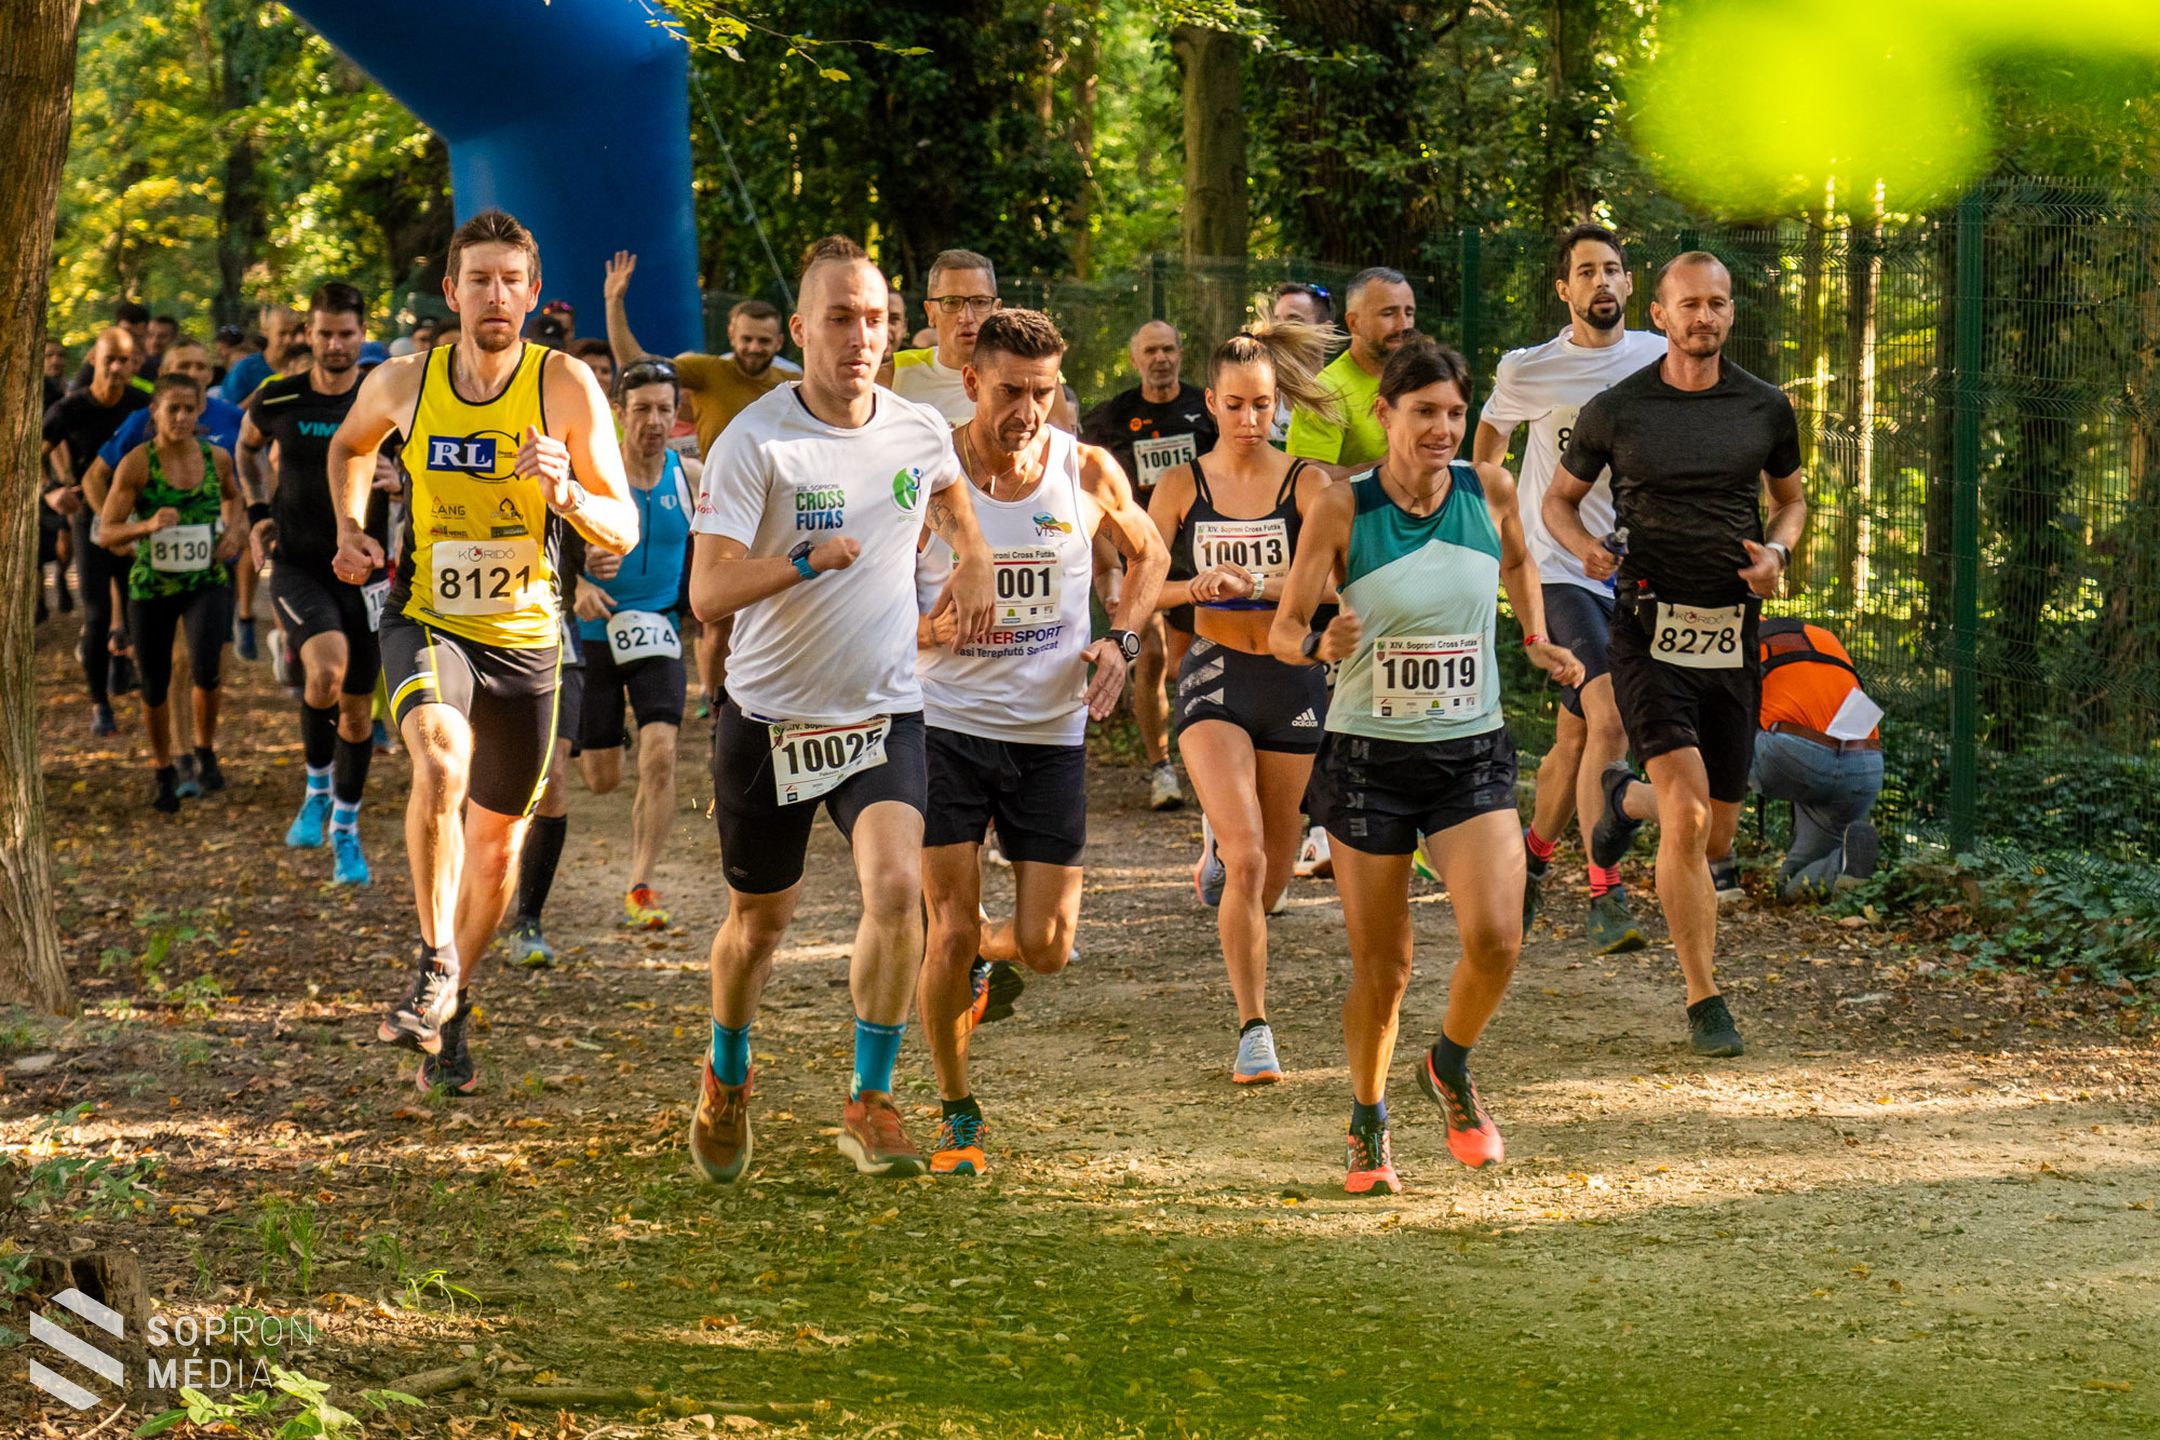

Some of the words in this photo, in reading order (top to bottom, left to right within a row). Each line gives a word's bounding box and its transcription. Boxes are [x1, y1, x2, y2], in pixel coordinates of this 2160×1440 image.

[1141, 446, 1192, 469] 10015
[796, 490, 845, 512] CROSS
[796, 508, 844, 531] FUTÁS
[155, 540, 209, 562] 8130
[1012, 551, 1034, 559] Cross
[1201, 538, 1283, 567] 10013
[440, 565, 531, 600] 8121
[997, 567, 1051, 599] 001
[615, 626, 676, 650] 8274
[1390, 641, 1405, 649] XIV.
[1406, 640, 1436, 650] Soproni
[1437, 640, 1458, 649] Cross
[1657, 627, 1737, 654] 8278
[976, 646, 1024, 659] Terepfutó
[1382, 656, 1476, 690] 10019
[1291, 720, 1319, 728] adidas
[781, 728, 883, 775] 10025
